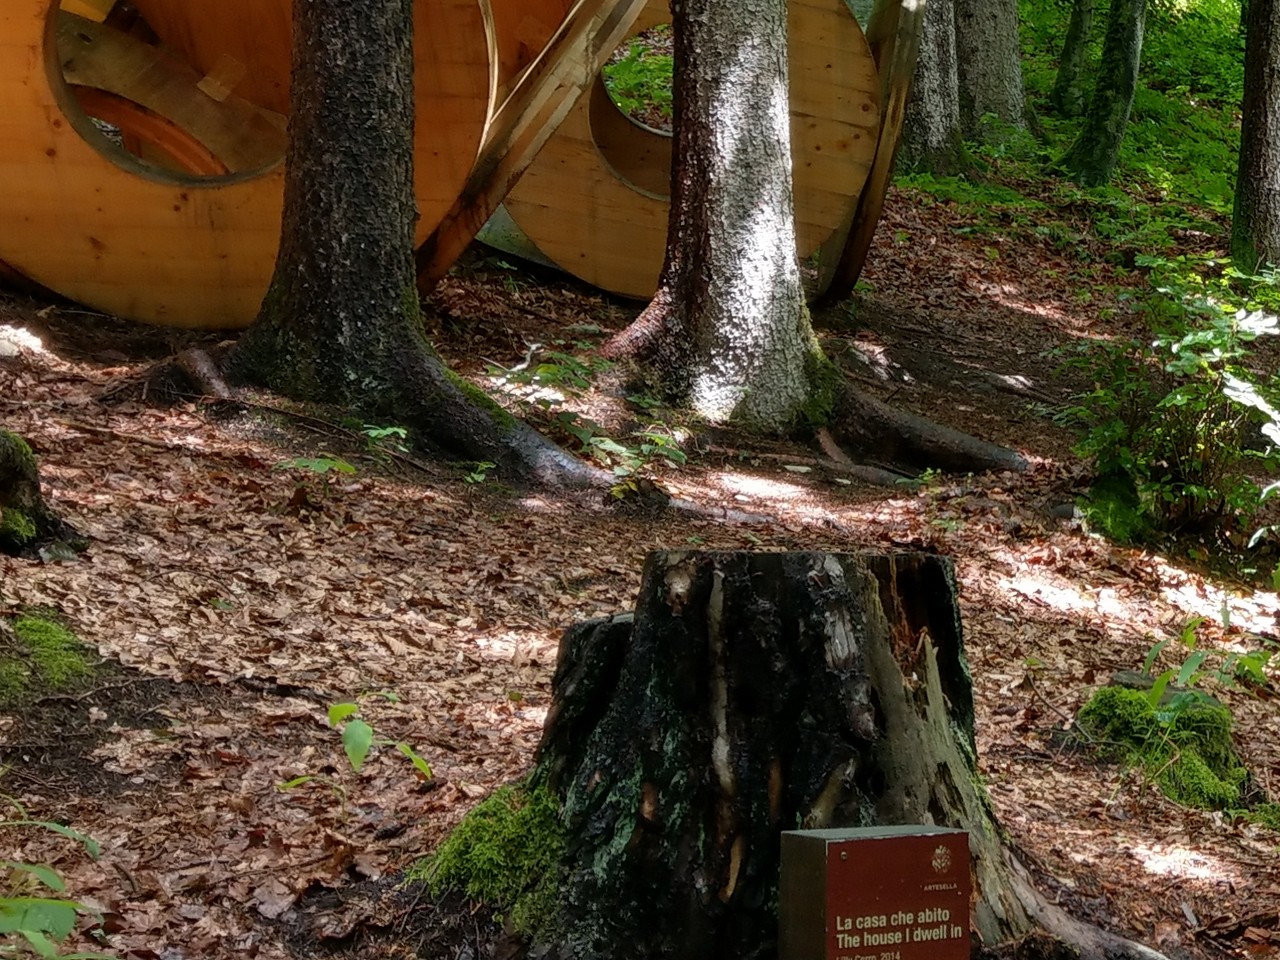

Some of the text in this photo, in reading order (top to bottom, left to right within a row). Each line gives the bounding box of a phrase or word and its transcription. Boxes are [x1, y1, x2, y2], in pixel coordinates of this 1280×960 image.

[924, 882, 957, 891] ARTESELLA
[836, 907, 950, 931] La casa che abito
[836, 933, 860, 949] The
[863, 930, 902, 946] house
[913, 925, 947, 942] dwell
[950, 923, 962, 939] in
[880, 951, 901, 960] 2014
